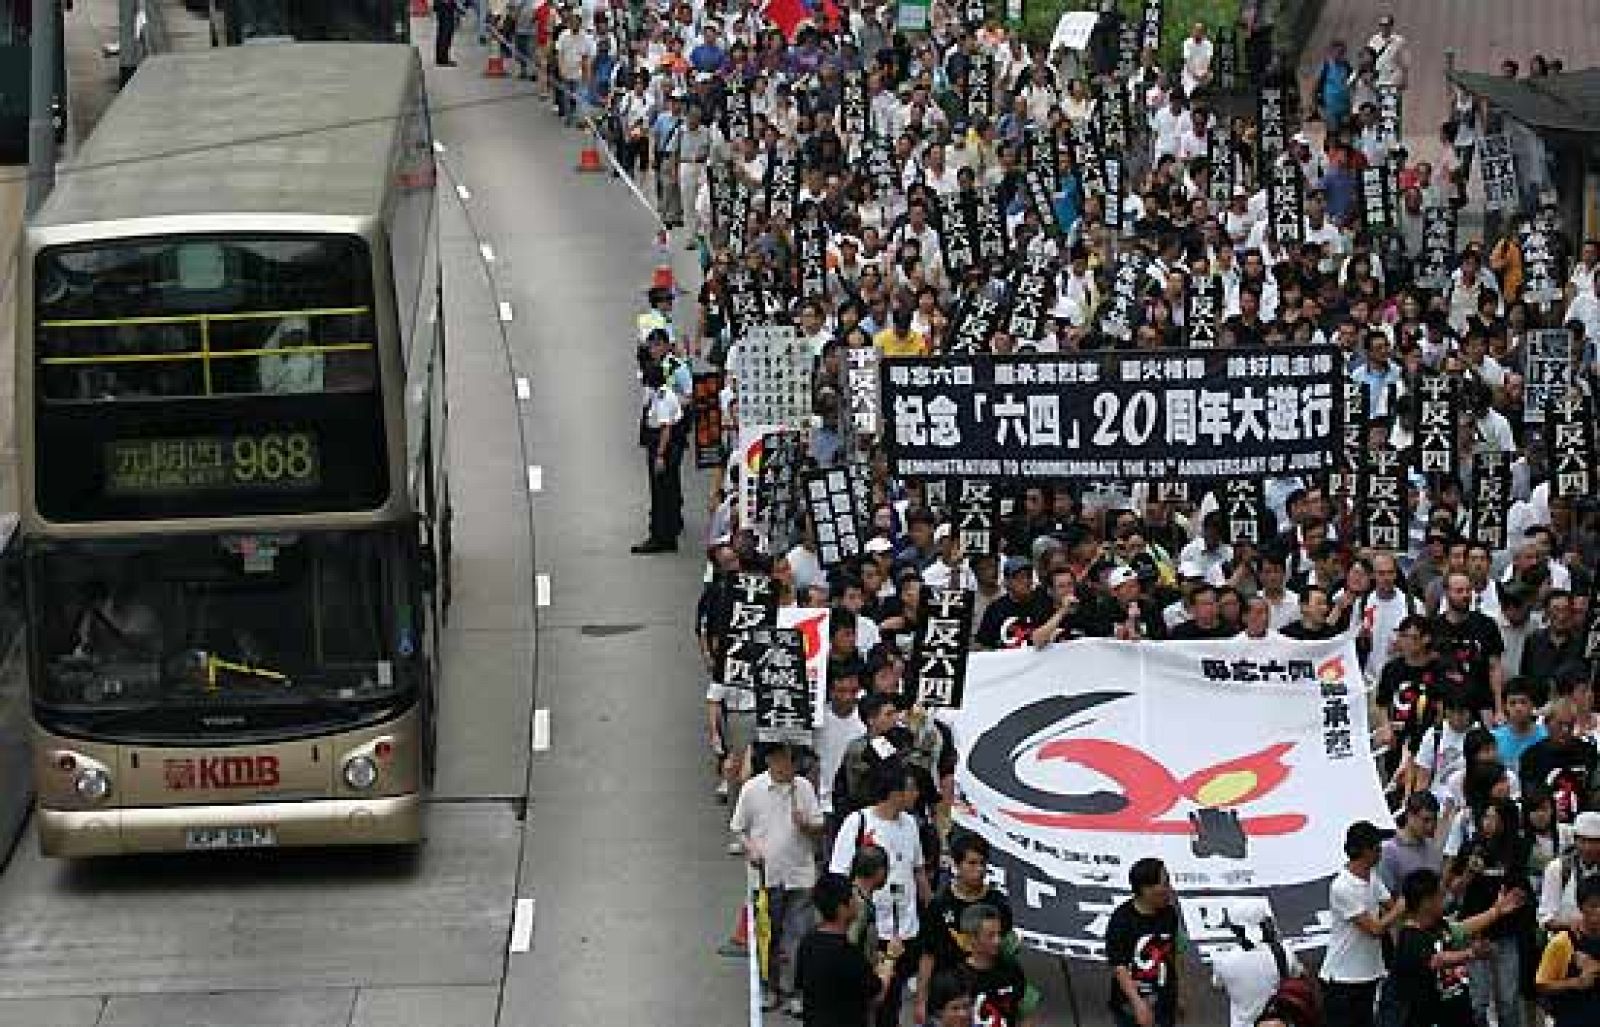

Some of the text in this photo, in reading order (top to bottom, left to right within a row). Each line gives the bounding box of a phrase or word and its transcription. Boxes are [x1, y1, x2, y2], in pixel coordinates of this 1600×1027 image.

[847, 349, 877, 434] 平反六四
[1423, 375, 1450, 472] 平反六四
[233, 434, 312, 481] 968
[1555, 396, 1599, 495] 平反六四
[1367, 452, 1400, 547] 平反六四
[918, 589, 965, 706] 平反六四
[199, 755, 281, 788] KMB
